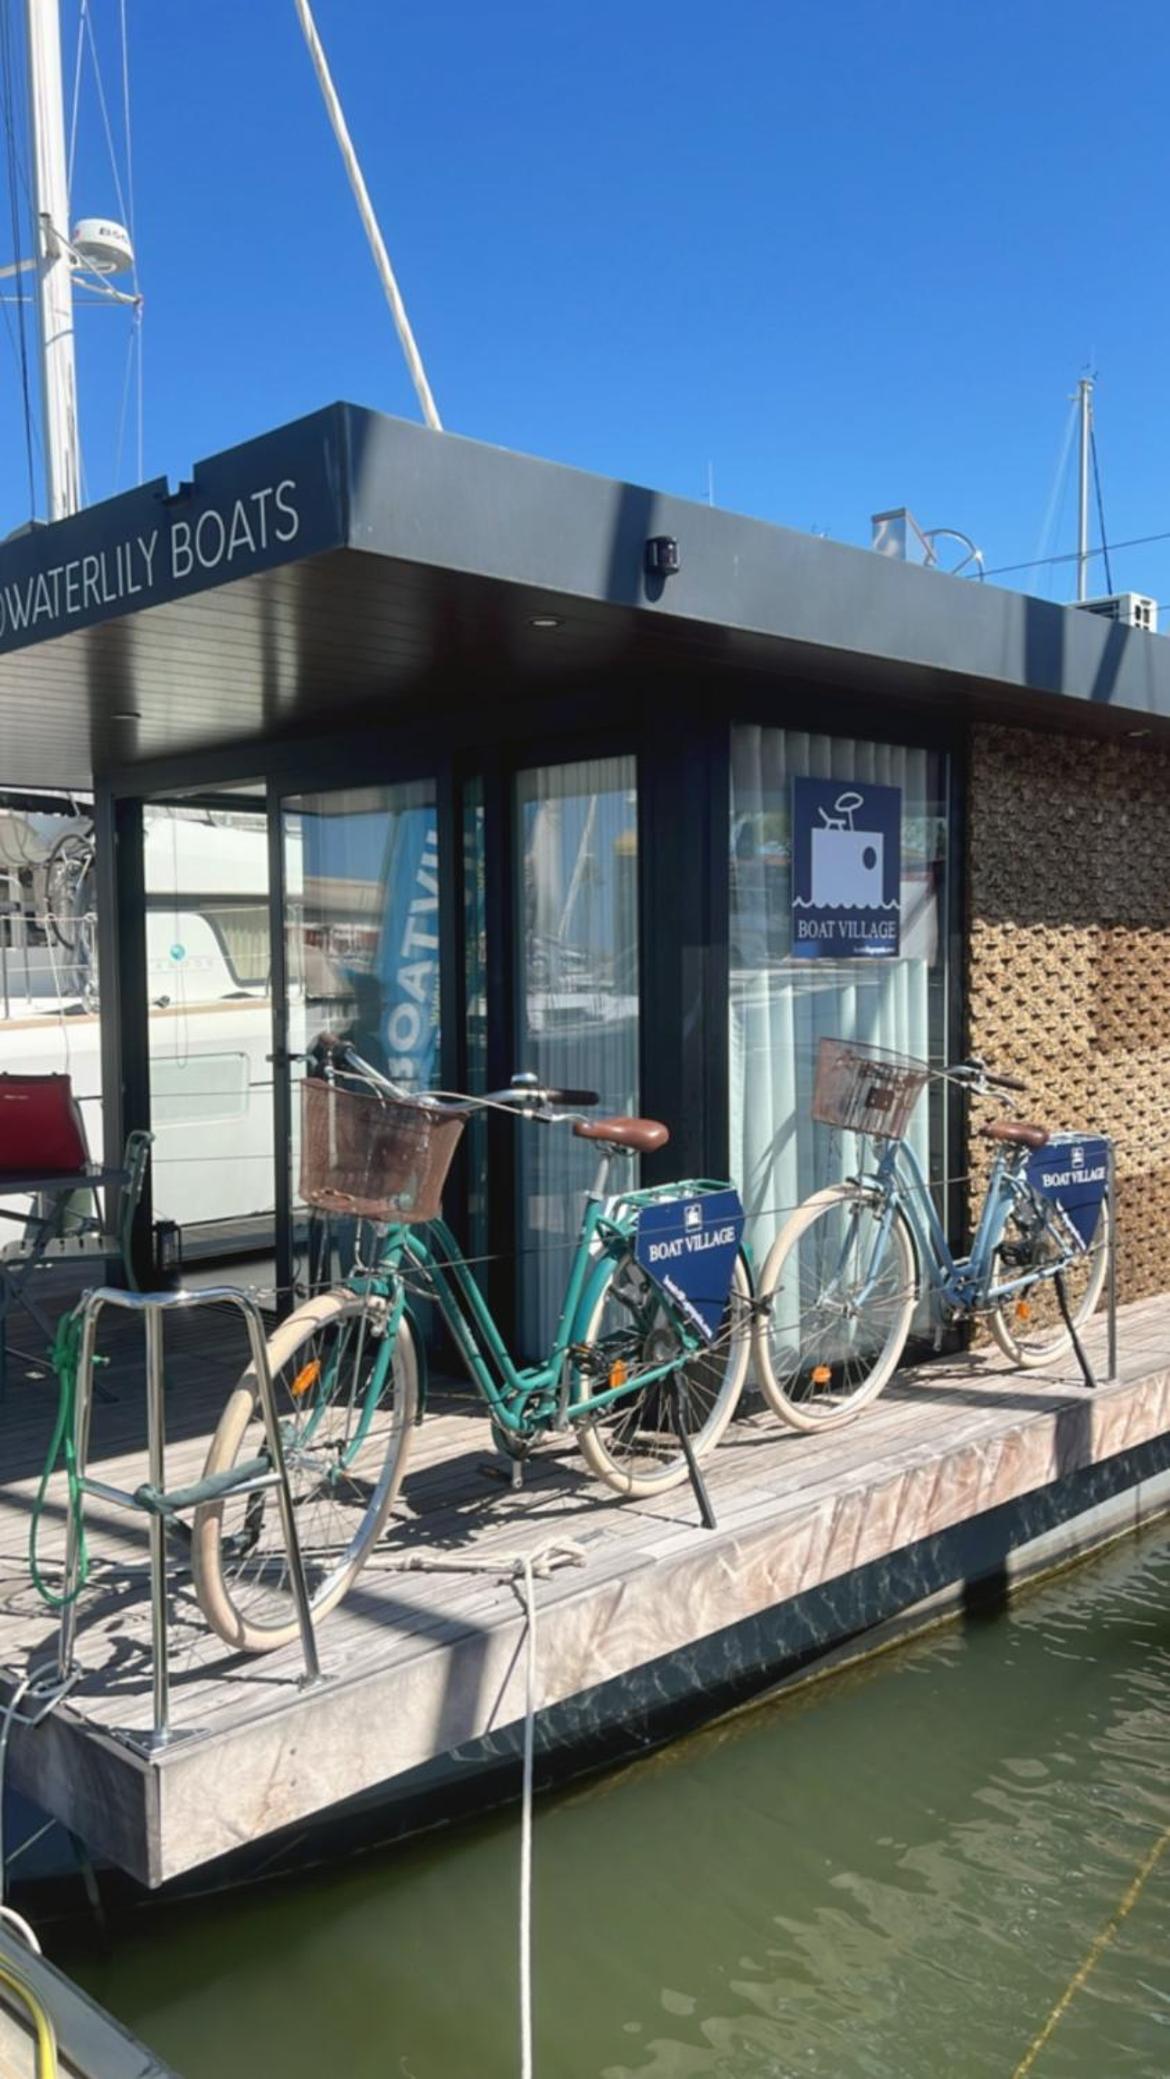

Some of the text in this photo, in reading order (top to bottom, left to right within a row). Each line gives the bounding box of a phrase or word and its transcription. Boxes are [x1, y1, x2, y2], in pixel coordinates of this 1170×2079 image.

[0, 479, 300, 637] WATERLILY BOATS
[798, 920, 897, 939] BOAT VILLAGE
[1042, 1166, 1106, 1188] BOAT VILLAGE
[648, 1226, 736, 1262] BOAT VILLAGE
